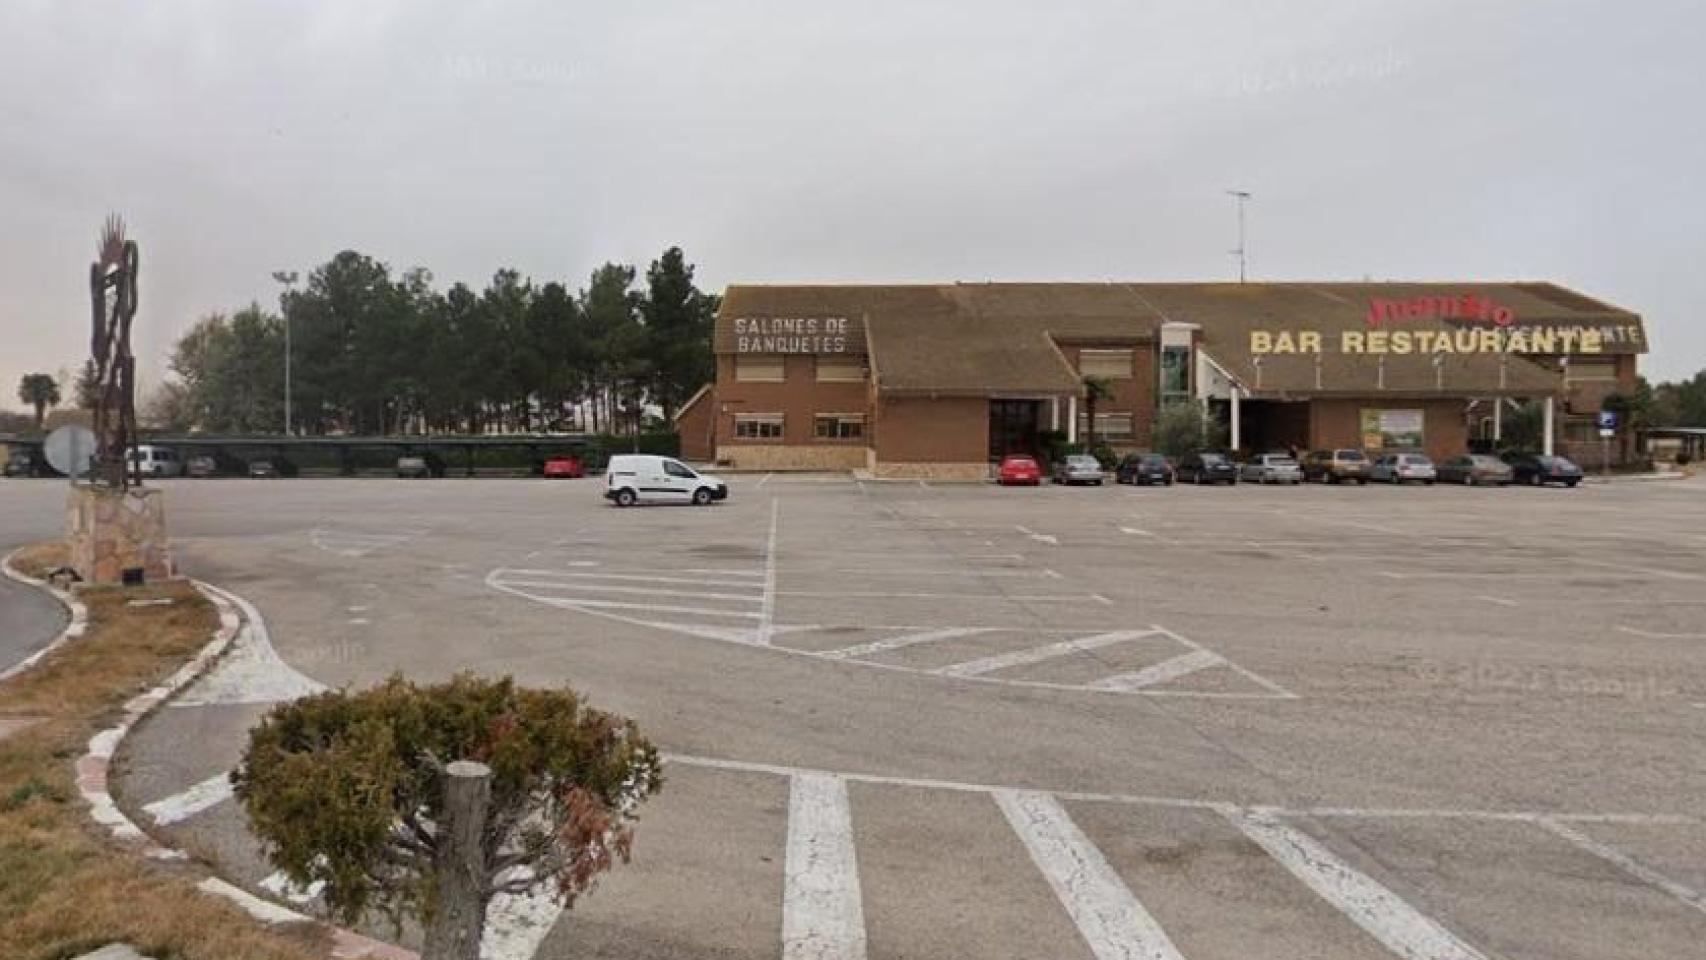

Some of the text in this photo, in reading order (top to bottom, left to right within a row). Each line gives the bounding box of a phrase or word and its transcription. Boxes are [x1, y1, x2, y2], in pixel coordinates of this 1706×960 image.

[734, 318, 848, 334] SALONES DE
[738, 336, 845, 353] BANQUETES
[1250, 331, 1321, 354] BAR
[1342, 331, 1602, 354] RESTAURANTE
